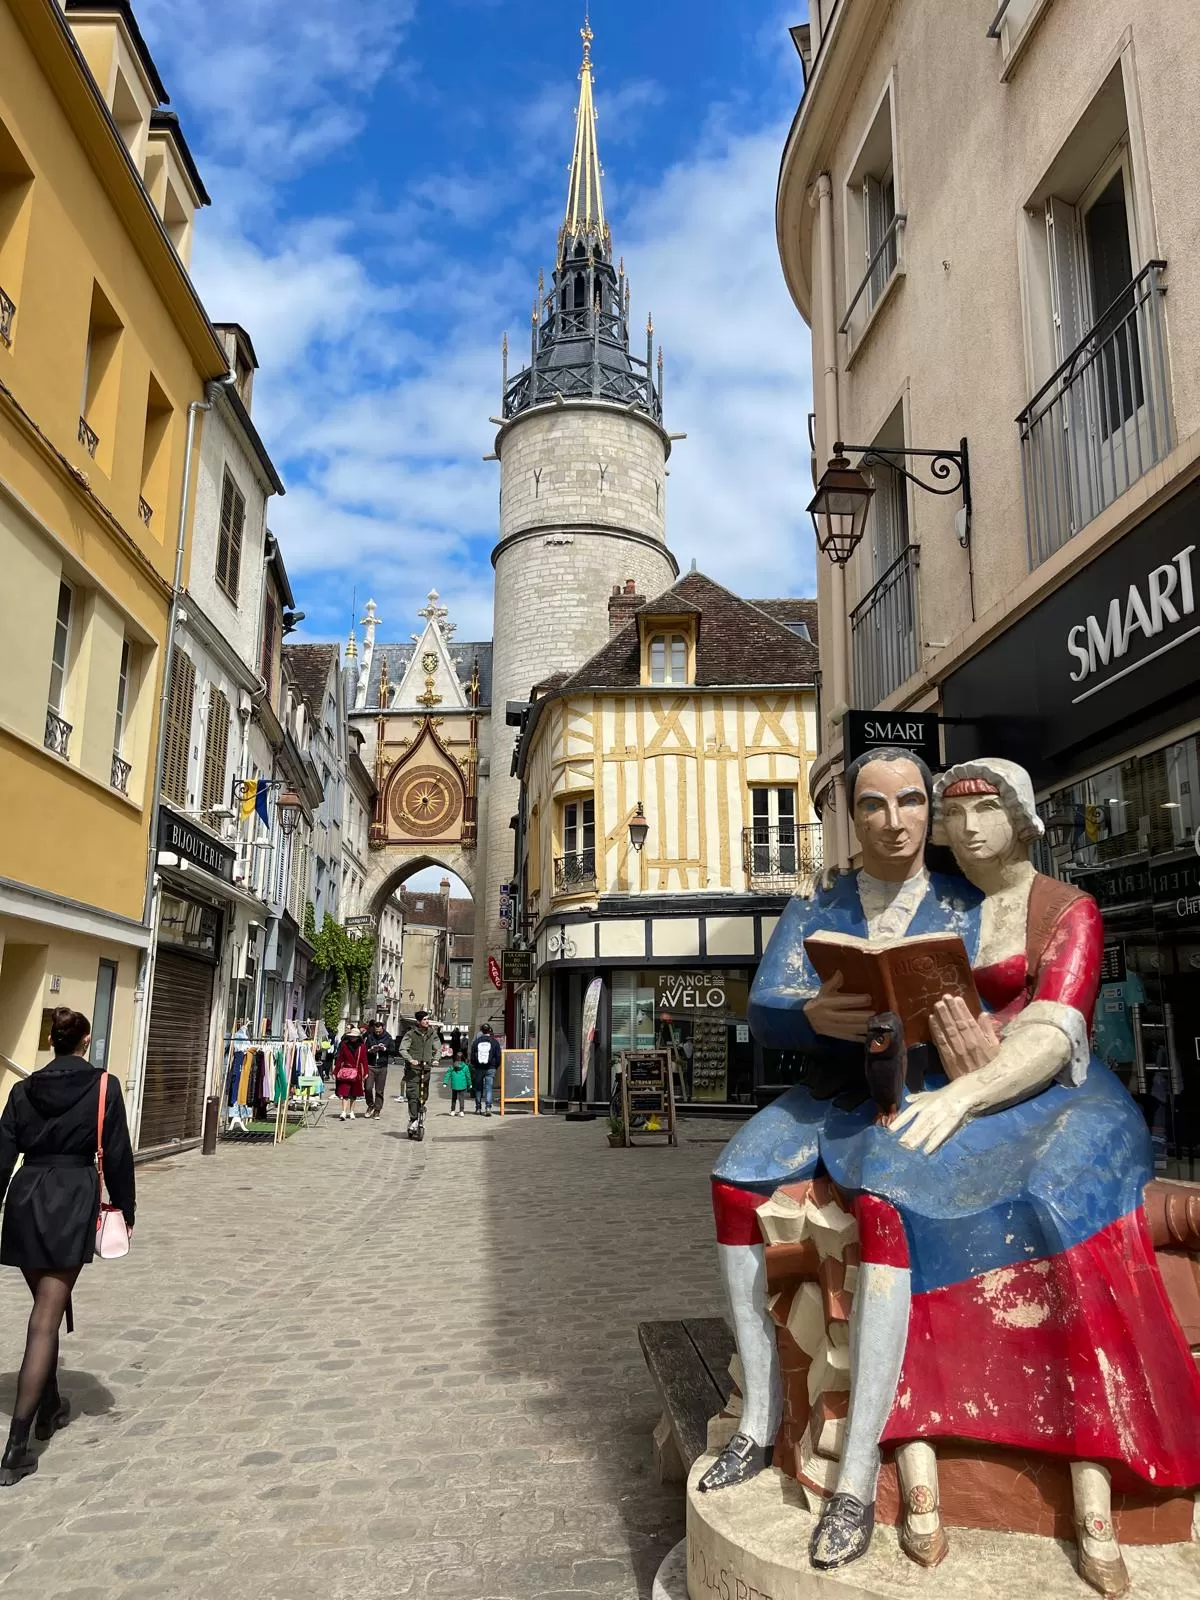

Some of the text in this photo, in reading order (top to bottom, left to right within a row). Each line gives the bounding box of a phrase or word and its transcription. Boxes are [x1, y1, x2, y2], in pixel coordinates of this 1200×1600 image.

[1067, 544, 1196, 682] SMART
[864, 721, 925, 740] SMART
[172, 825, 224, 871] BIJOUTERIE
[499, 884, 510, 930] LOTO
[490, 960, 501, 987] TABAC
[659, 975, 712, 987] FRANCE
[666, 986, 726, 1007] VÉLO
